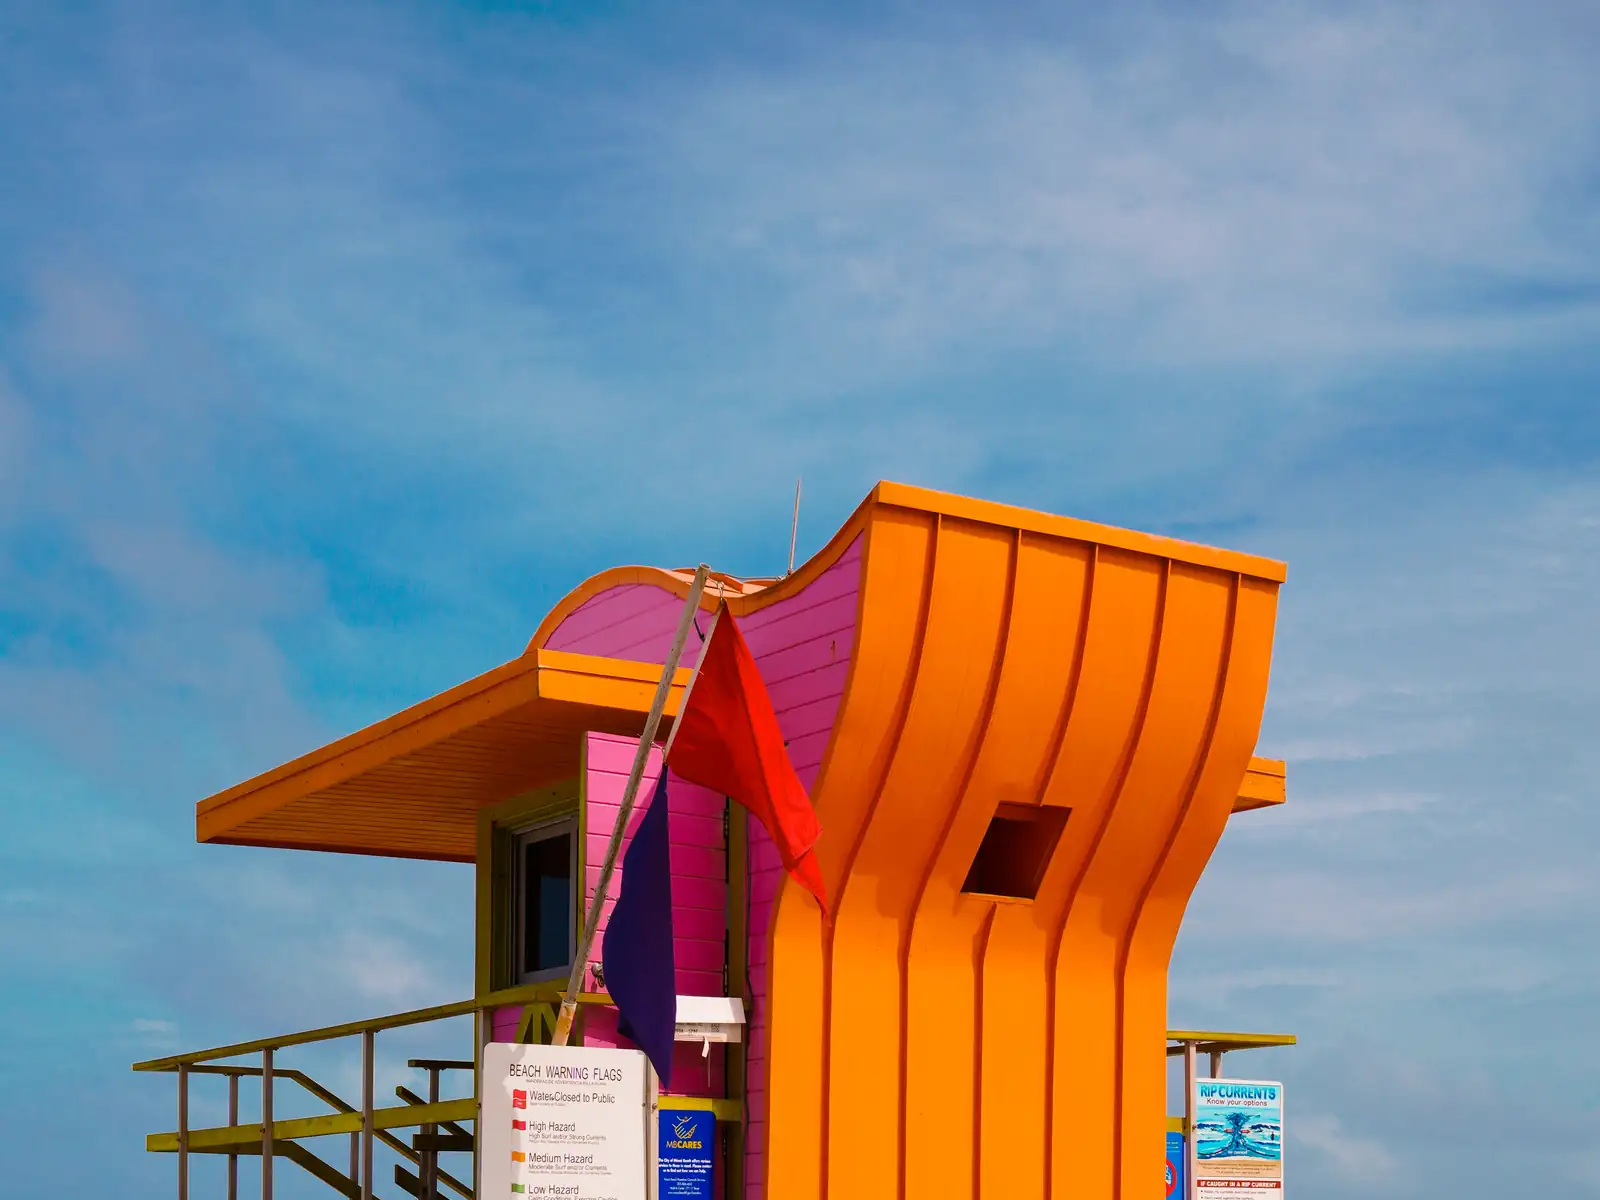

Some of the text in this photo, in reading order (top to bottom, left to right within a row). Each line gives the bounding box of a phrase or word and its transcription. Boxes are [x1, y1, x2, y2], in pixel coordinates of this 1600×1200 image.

[509, 1063, 622, 1081] BEACH WARNING FLAGS
[554, 1091, 580, 1102] Closed
[583, 1093, 590, 1103] to
[592, 1093, 615, 1104] Public
[1218, 1086, 1276, 1100] CURRENTS
[529, 1121, 576, 1133] High Hazard
[528, 1152, 593, 1164] Medium Hazard
[528, 1184, 579, 1195] Low Hazard
